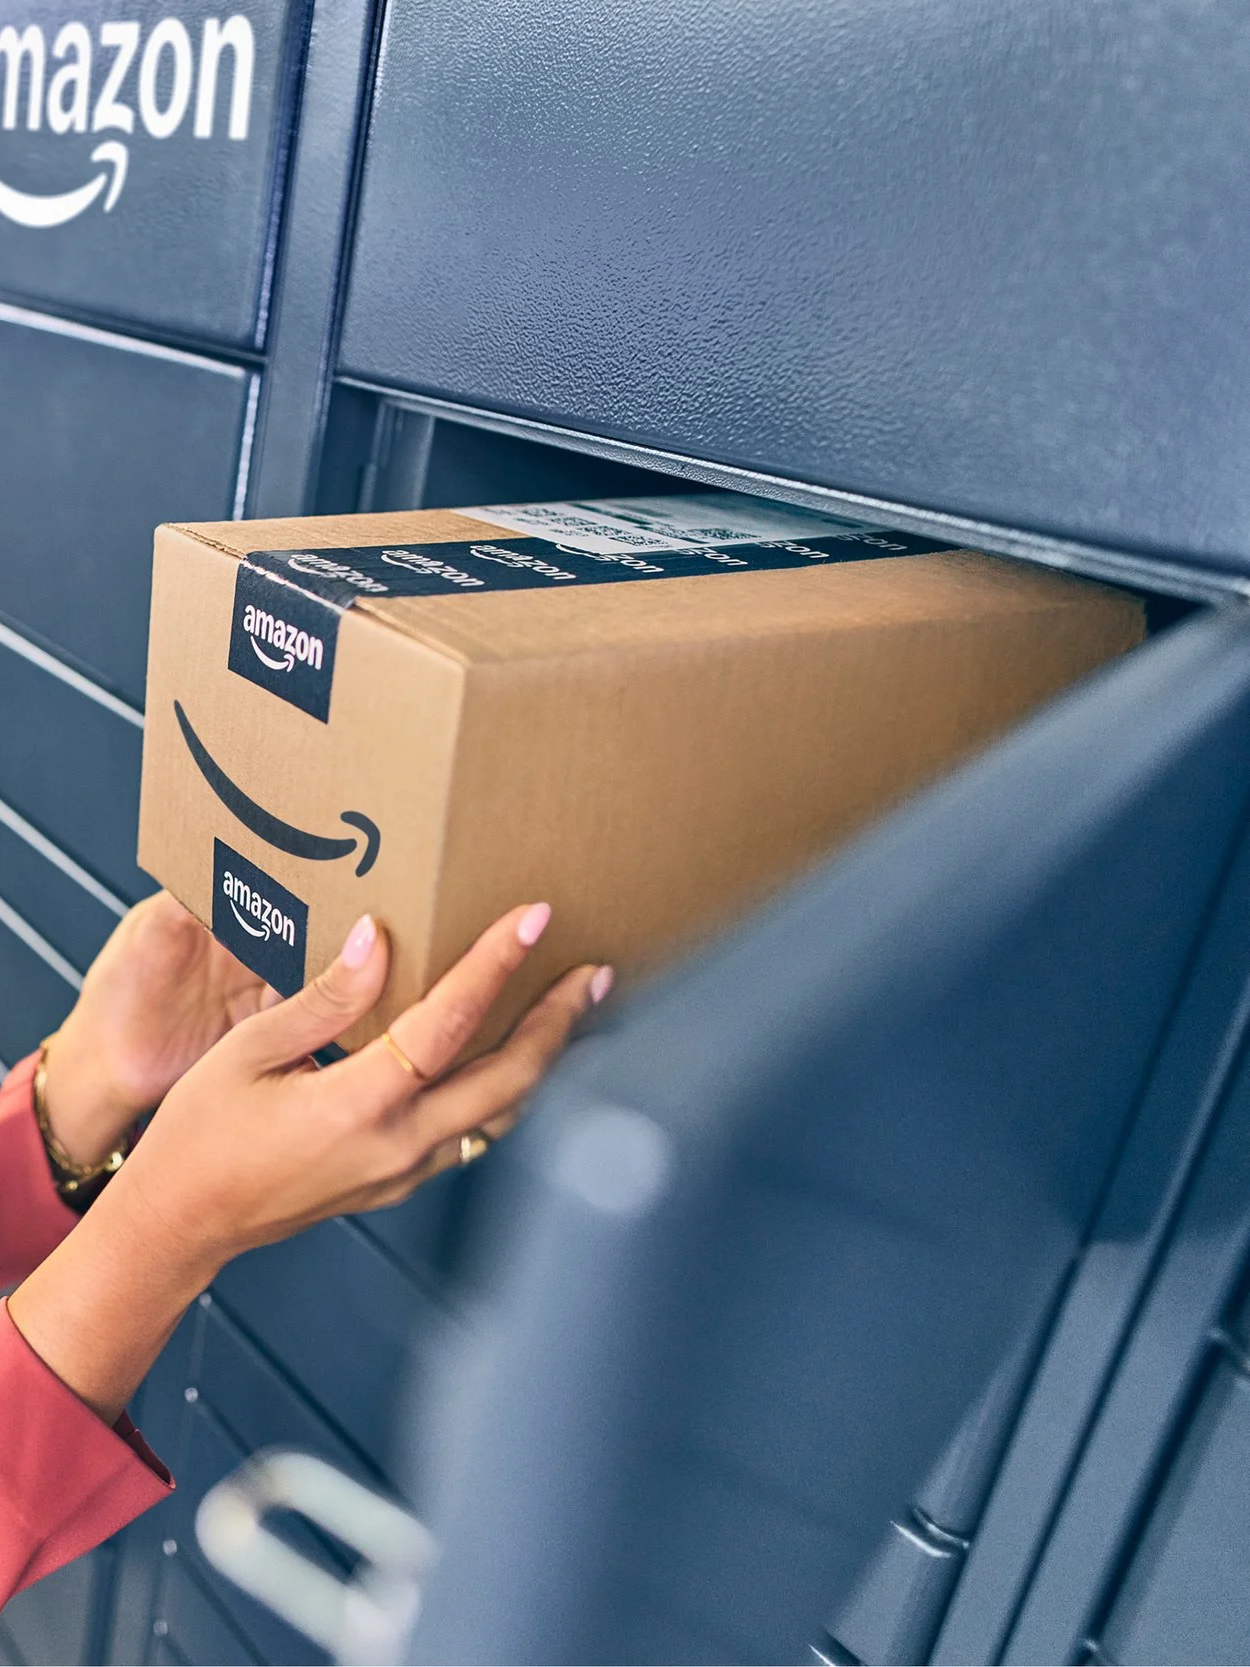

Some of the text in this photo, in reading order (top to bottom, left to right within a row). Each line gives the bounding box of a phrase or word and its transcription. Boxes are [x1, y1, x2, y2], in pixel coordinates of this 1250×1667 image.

[290, 553, 389, 592] amazon
[381, 549, 485, 587] amazon
[469, 544, 577, 580] amazon
[243, 604, 324, 671] amazon
[222, 870, 295, 947] amazon
